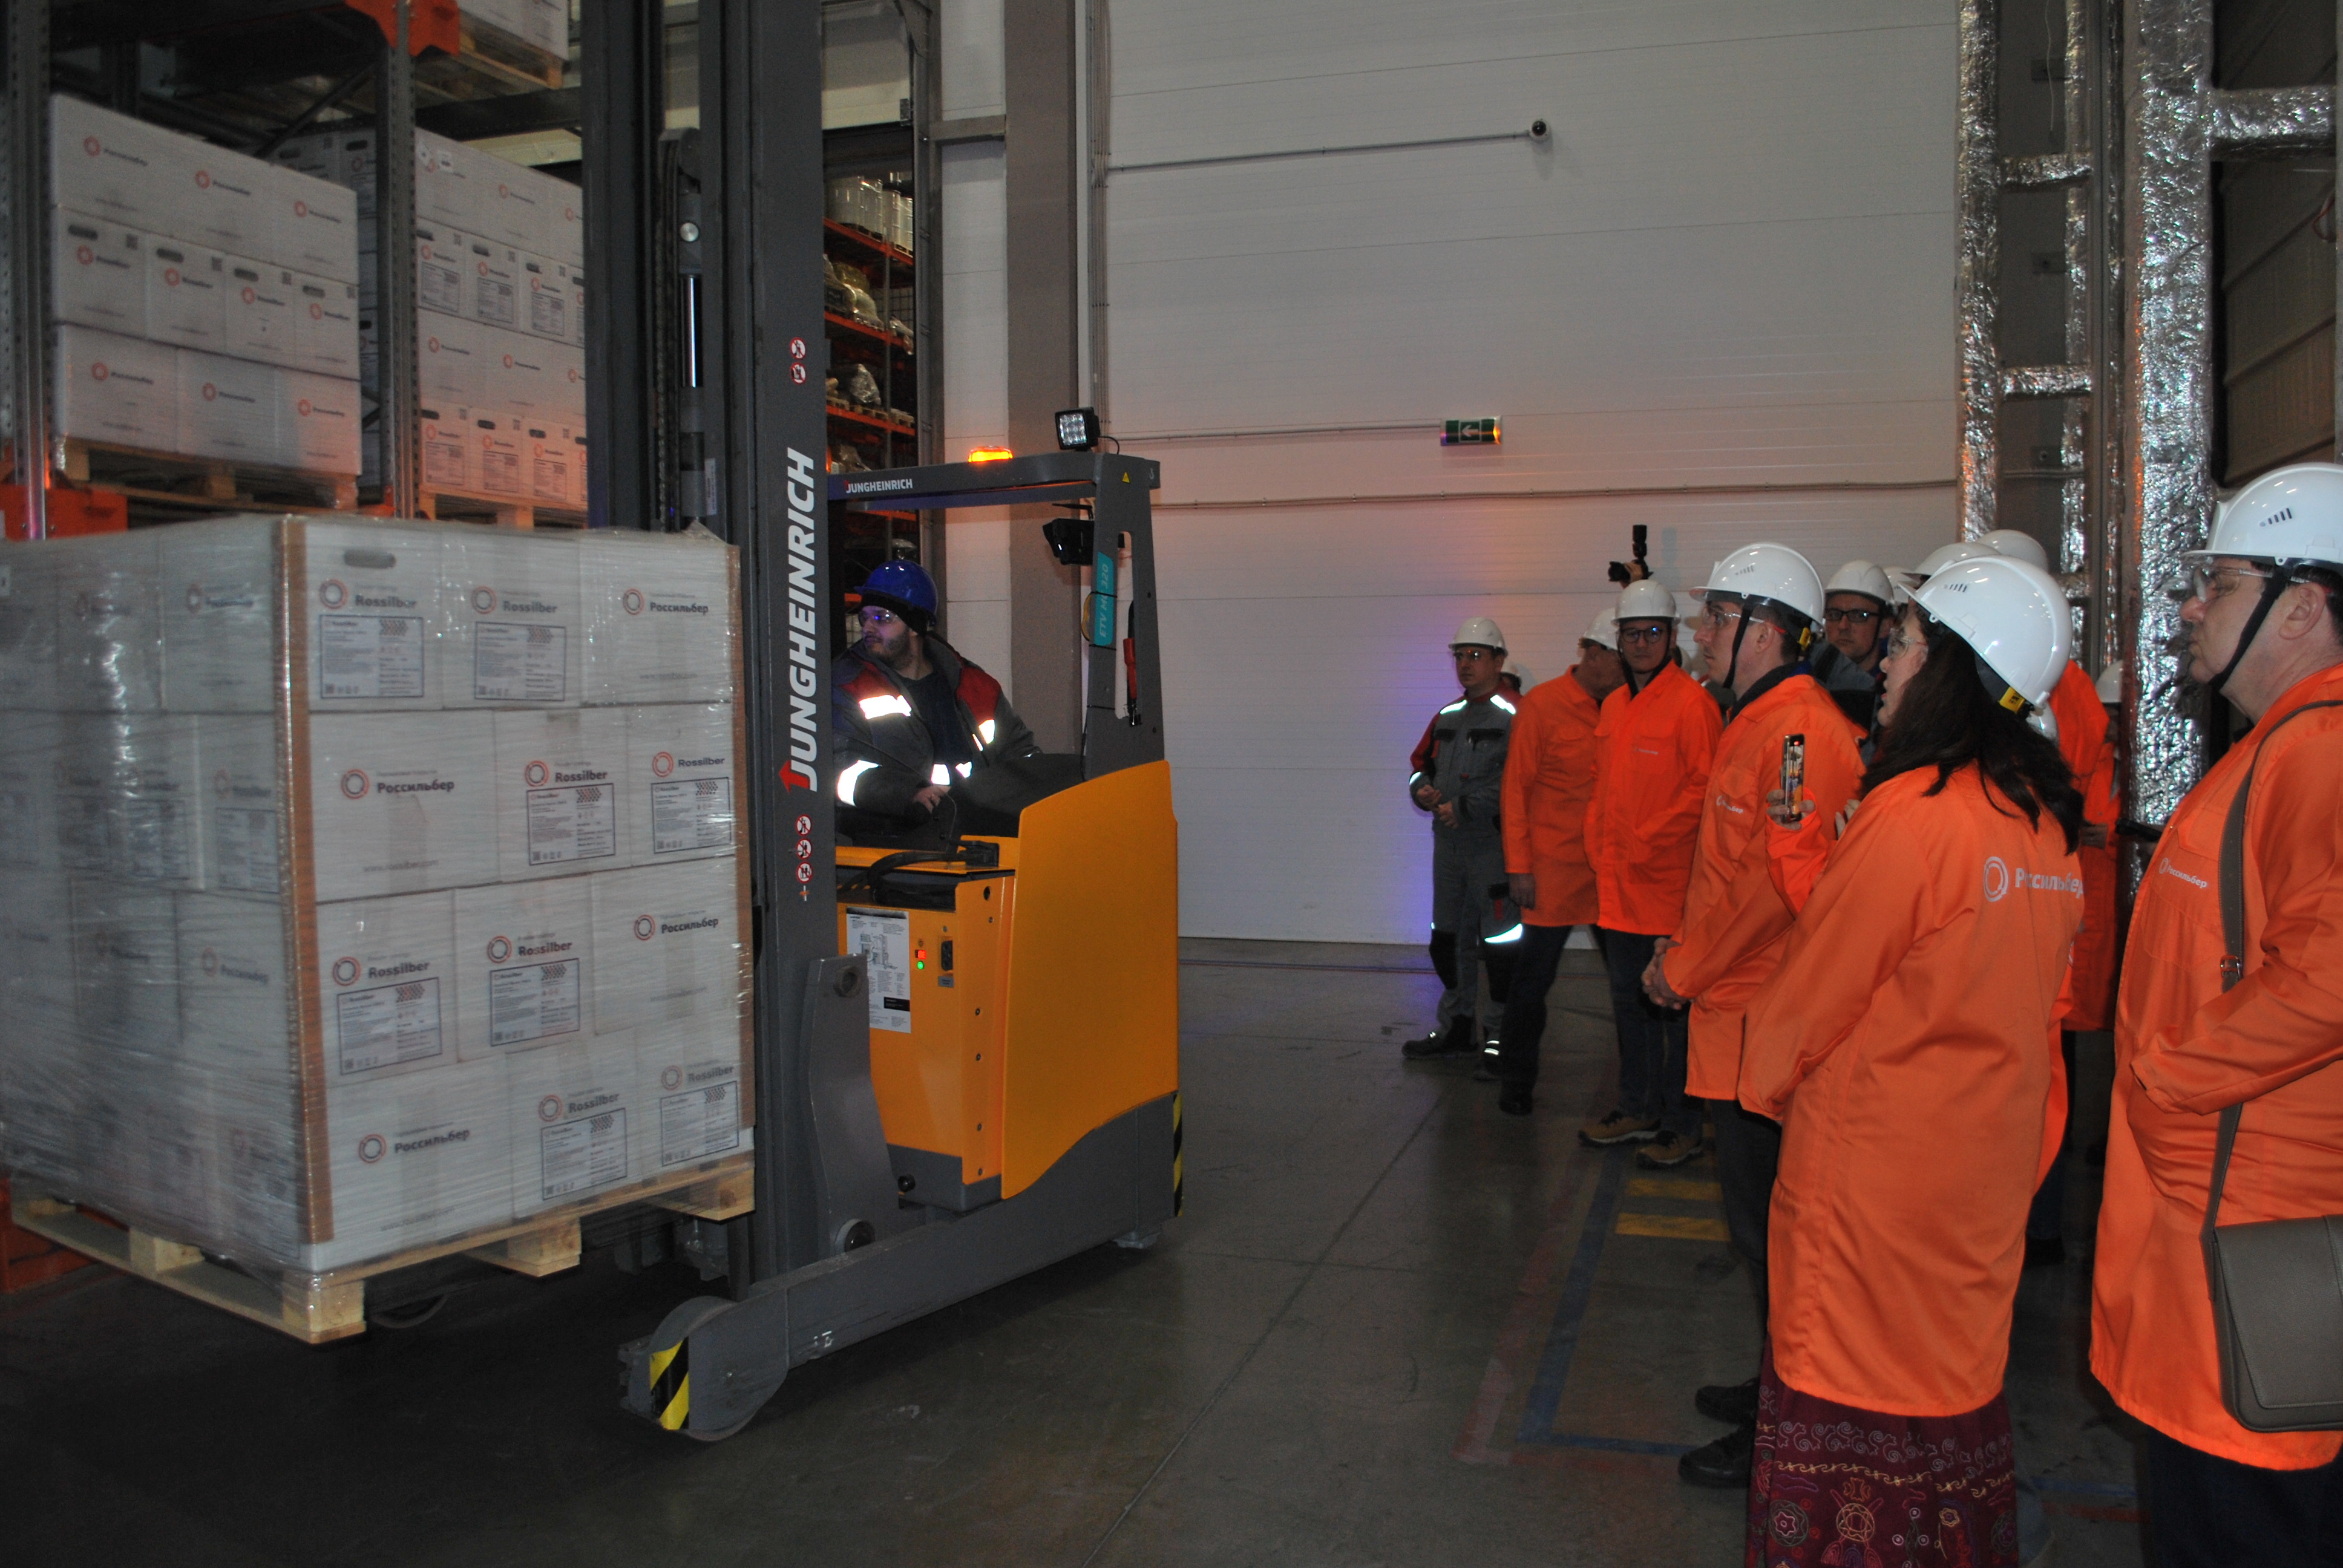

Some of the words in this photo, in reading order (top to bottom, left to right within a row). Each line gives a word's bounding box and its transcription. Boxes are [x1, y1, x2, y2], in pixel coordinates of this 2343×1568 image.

[845, 479, 913, 494] JUNGHEINRICH
[503, 600, 557, 613] Rossilber
[649, 602, 709, 616] Россильбер
[786, 446, 818, 792] JUNGHEINRICH
[678, 757, 725, 768] Rossilber
[555, 770, 608, 782] Rossilber
[377, 779, 454, 794] Россильбер
[661, 918, 718, 933] Россильбер
[519, 941, 572, 956] Rossilber
[368, 962, 430, 979] Rossilber
[688, 1067, 733, 1082] Rossilber
[568, 1094, 620, 1114] Rossilber
[395, 1129, 470, 1154] Россильбер
